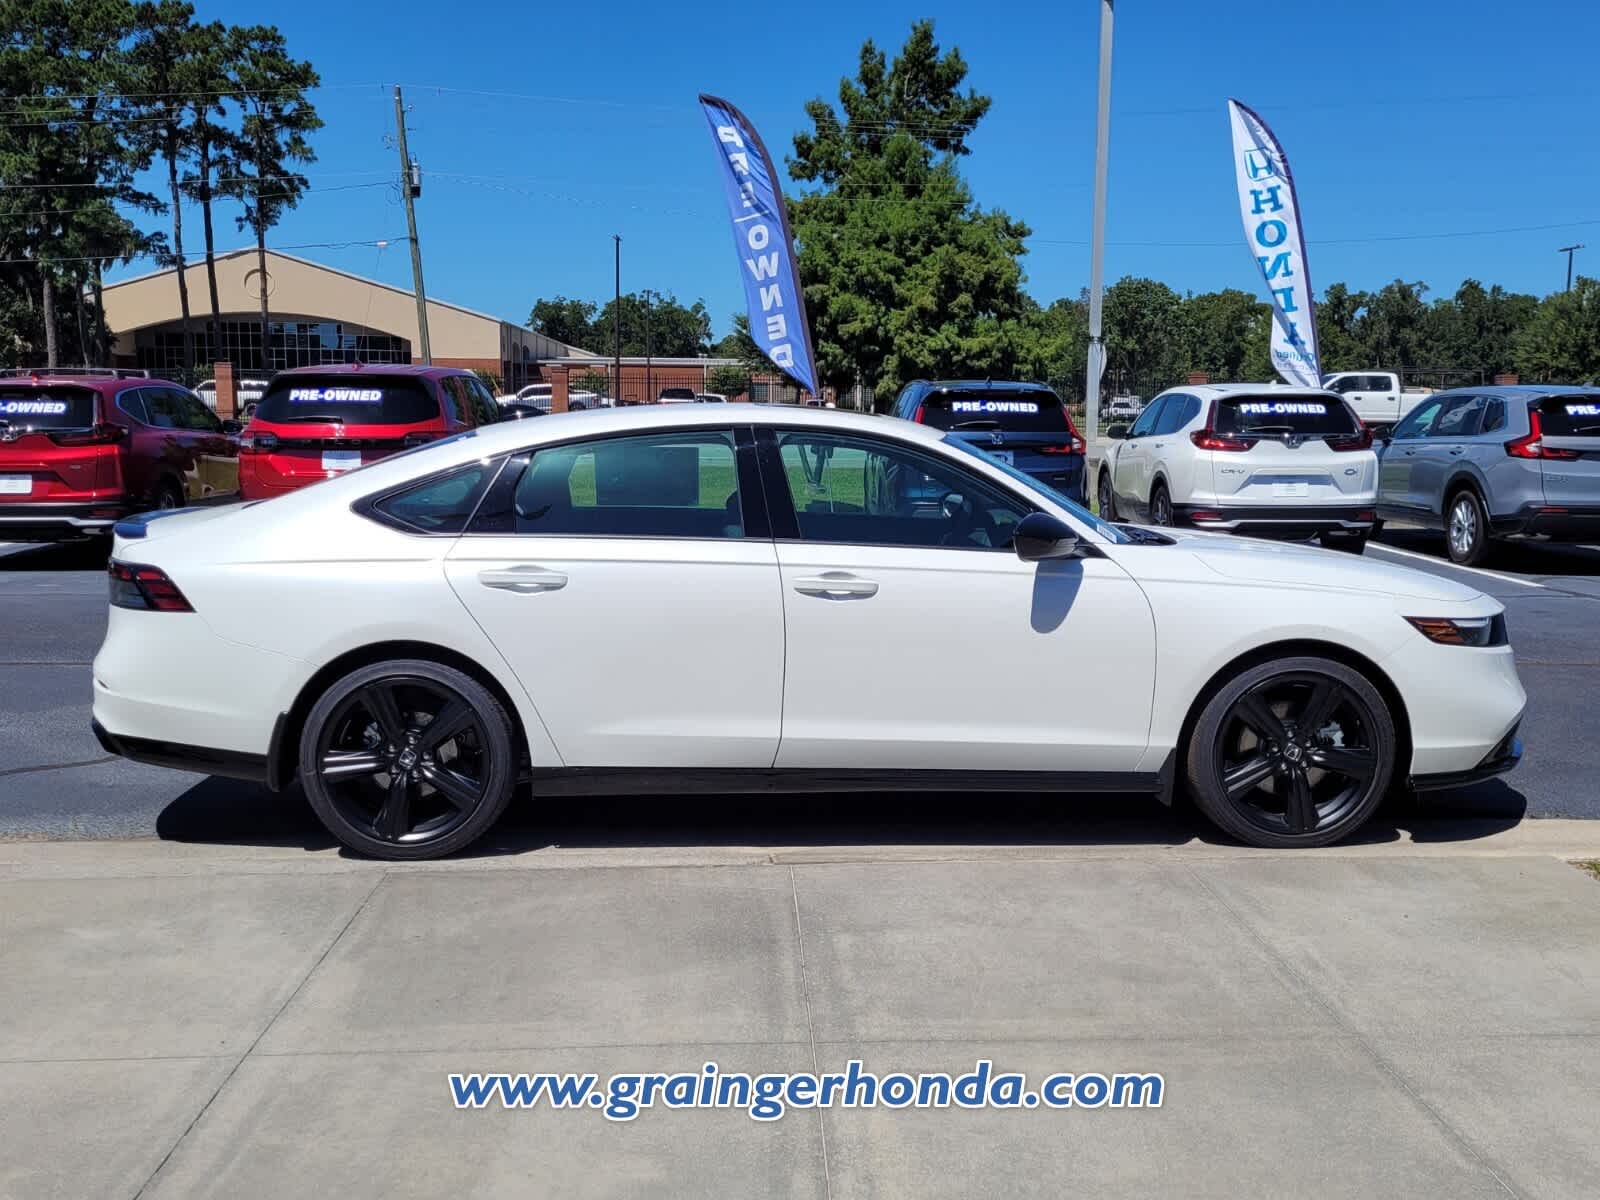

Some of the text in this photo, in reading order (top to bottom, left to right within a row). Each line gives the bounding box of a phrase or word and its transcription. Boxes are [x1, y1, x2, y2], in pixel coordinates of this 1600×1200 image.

[289, 389, 381, 401] PRE-OWNED
[0, 402, 66, 413] -OWNED
[952, 402, 1038, 413] PRE-OWNED
[1240, 403, 1326, 414] PRE-OWNED
